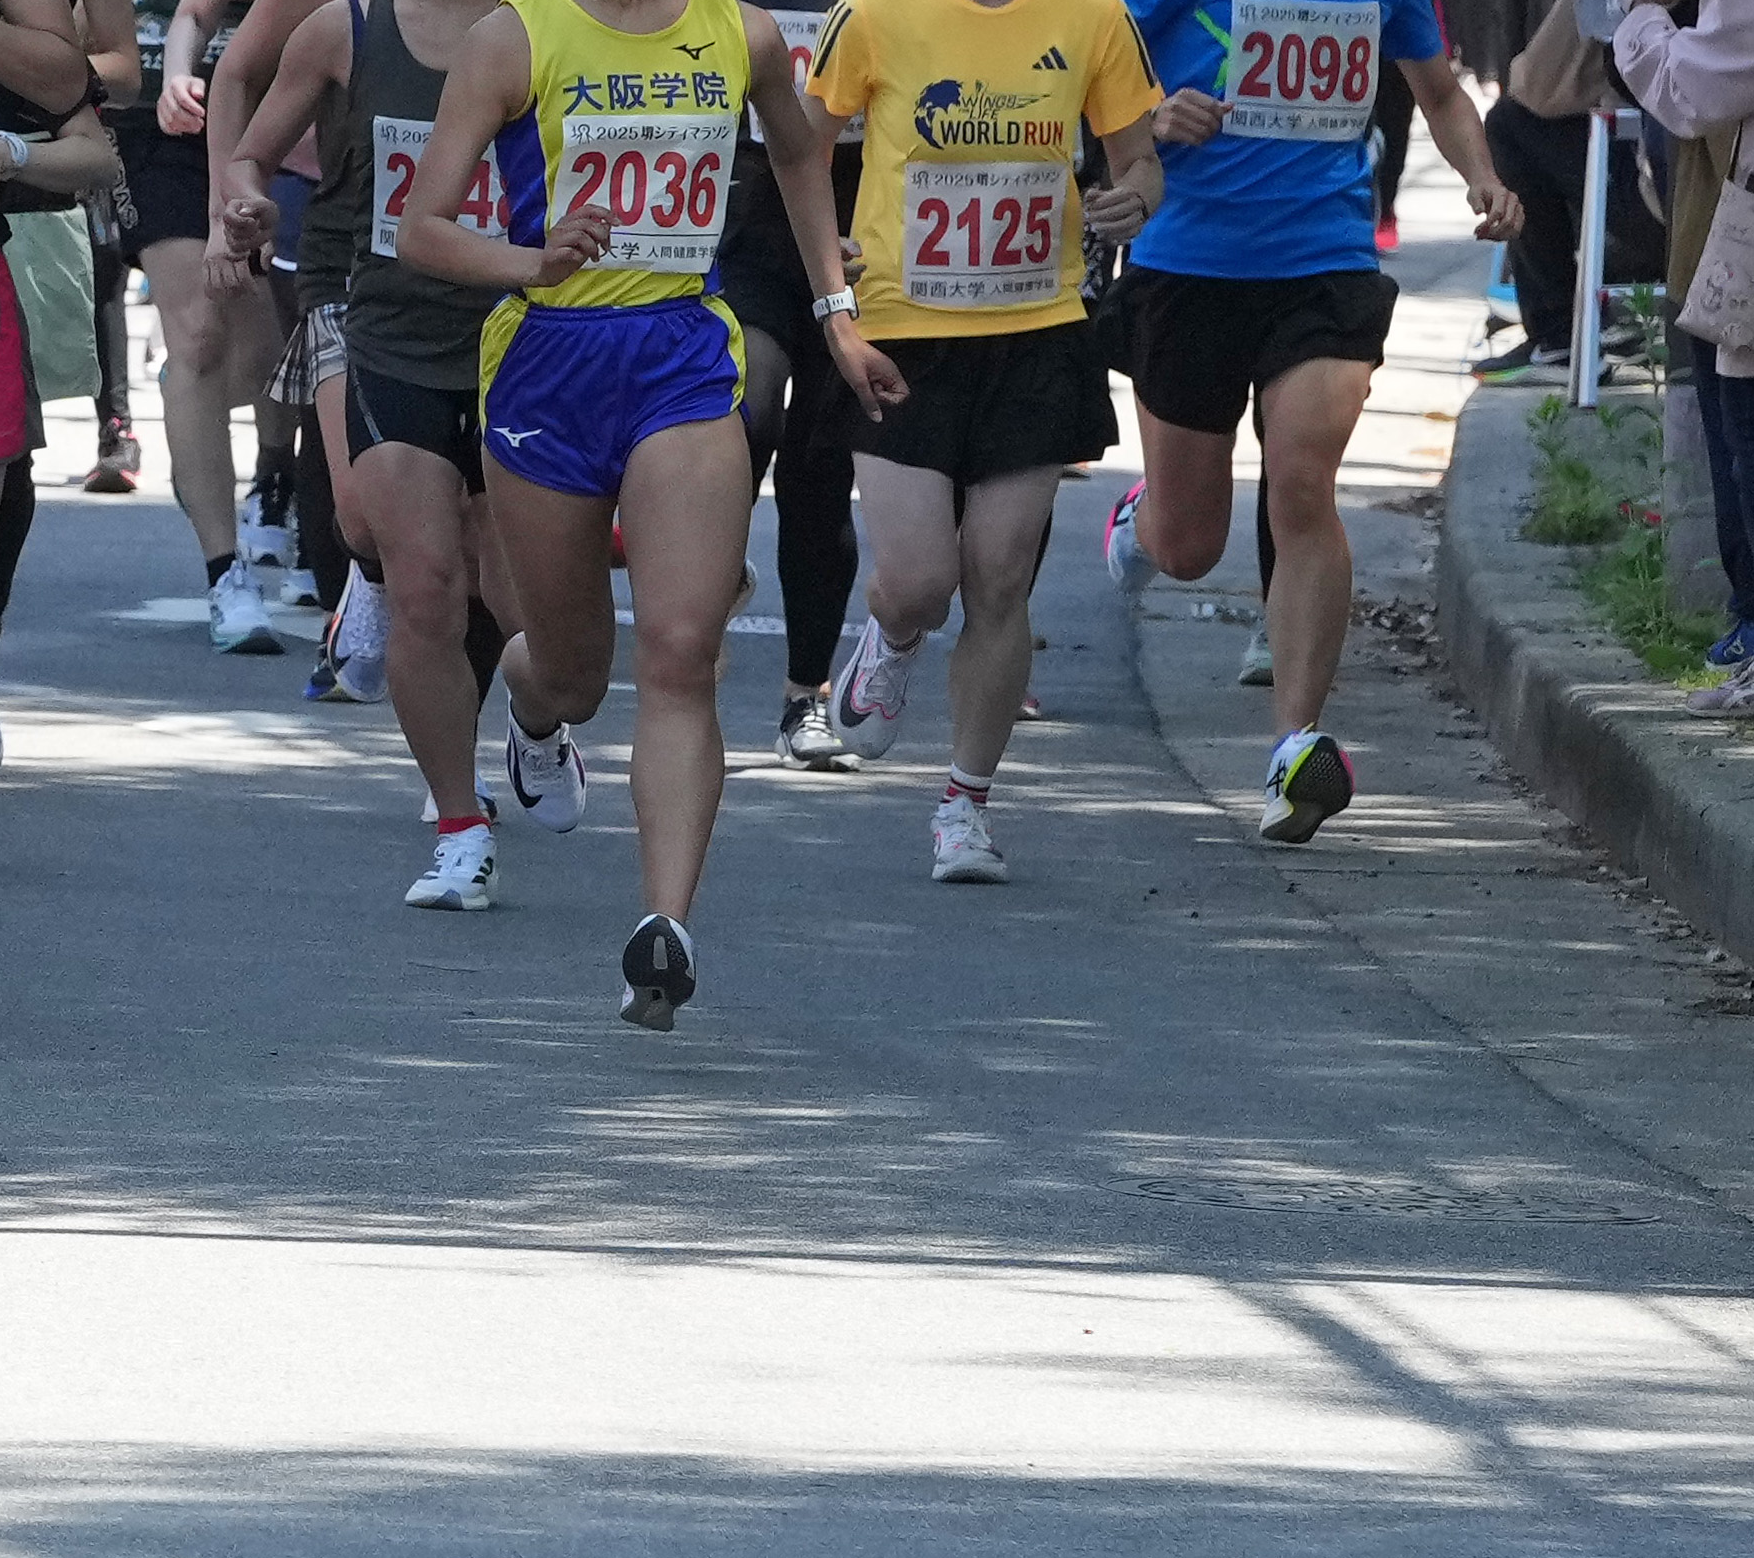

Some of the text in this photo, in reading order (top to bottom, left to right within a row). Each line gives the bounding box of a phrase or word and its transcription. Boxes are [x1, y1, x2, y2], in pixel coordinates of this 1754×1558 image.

[562, 71, 730, 116] 大阪学院
[1237, 30, 1371, 103] 2098
[941, 120, 1064, 146] WORLD RUN
[565, 150, 721, 229] 2036
[915, 196, 1054, 267] 2125
